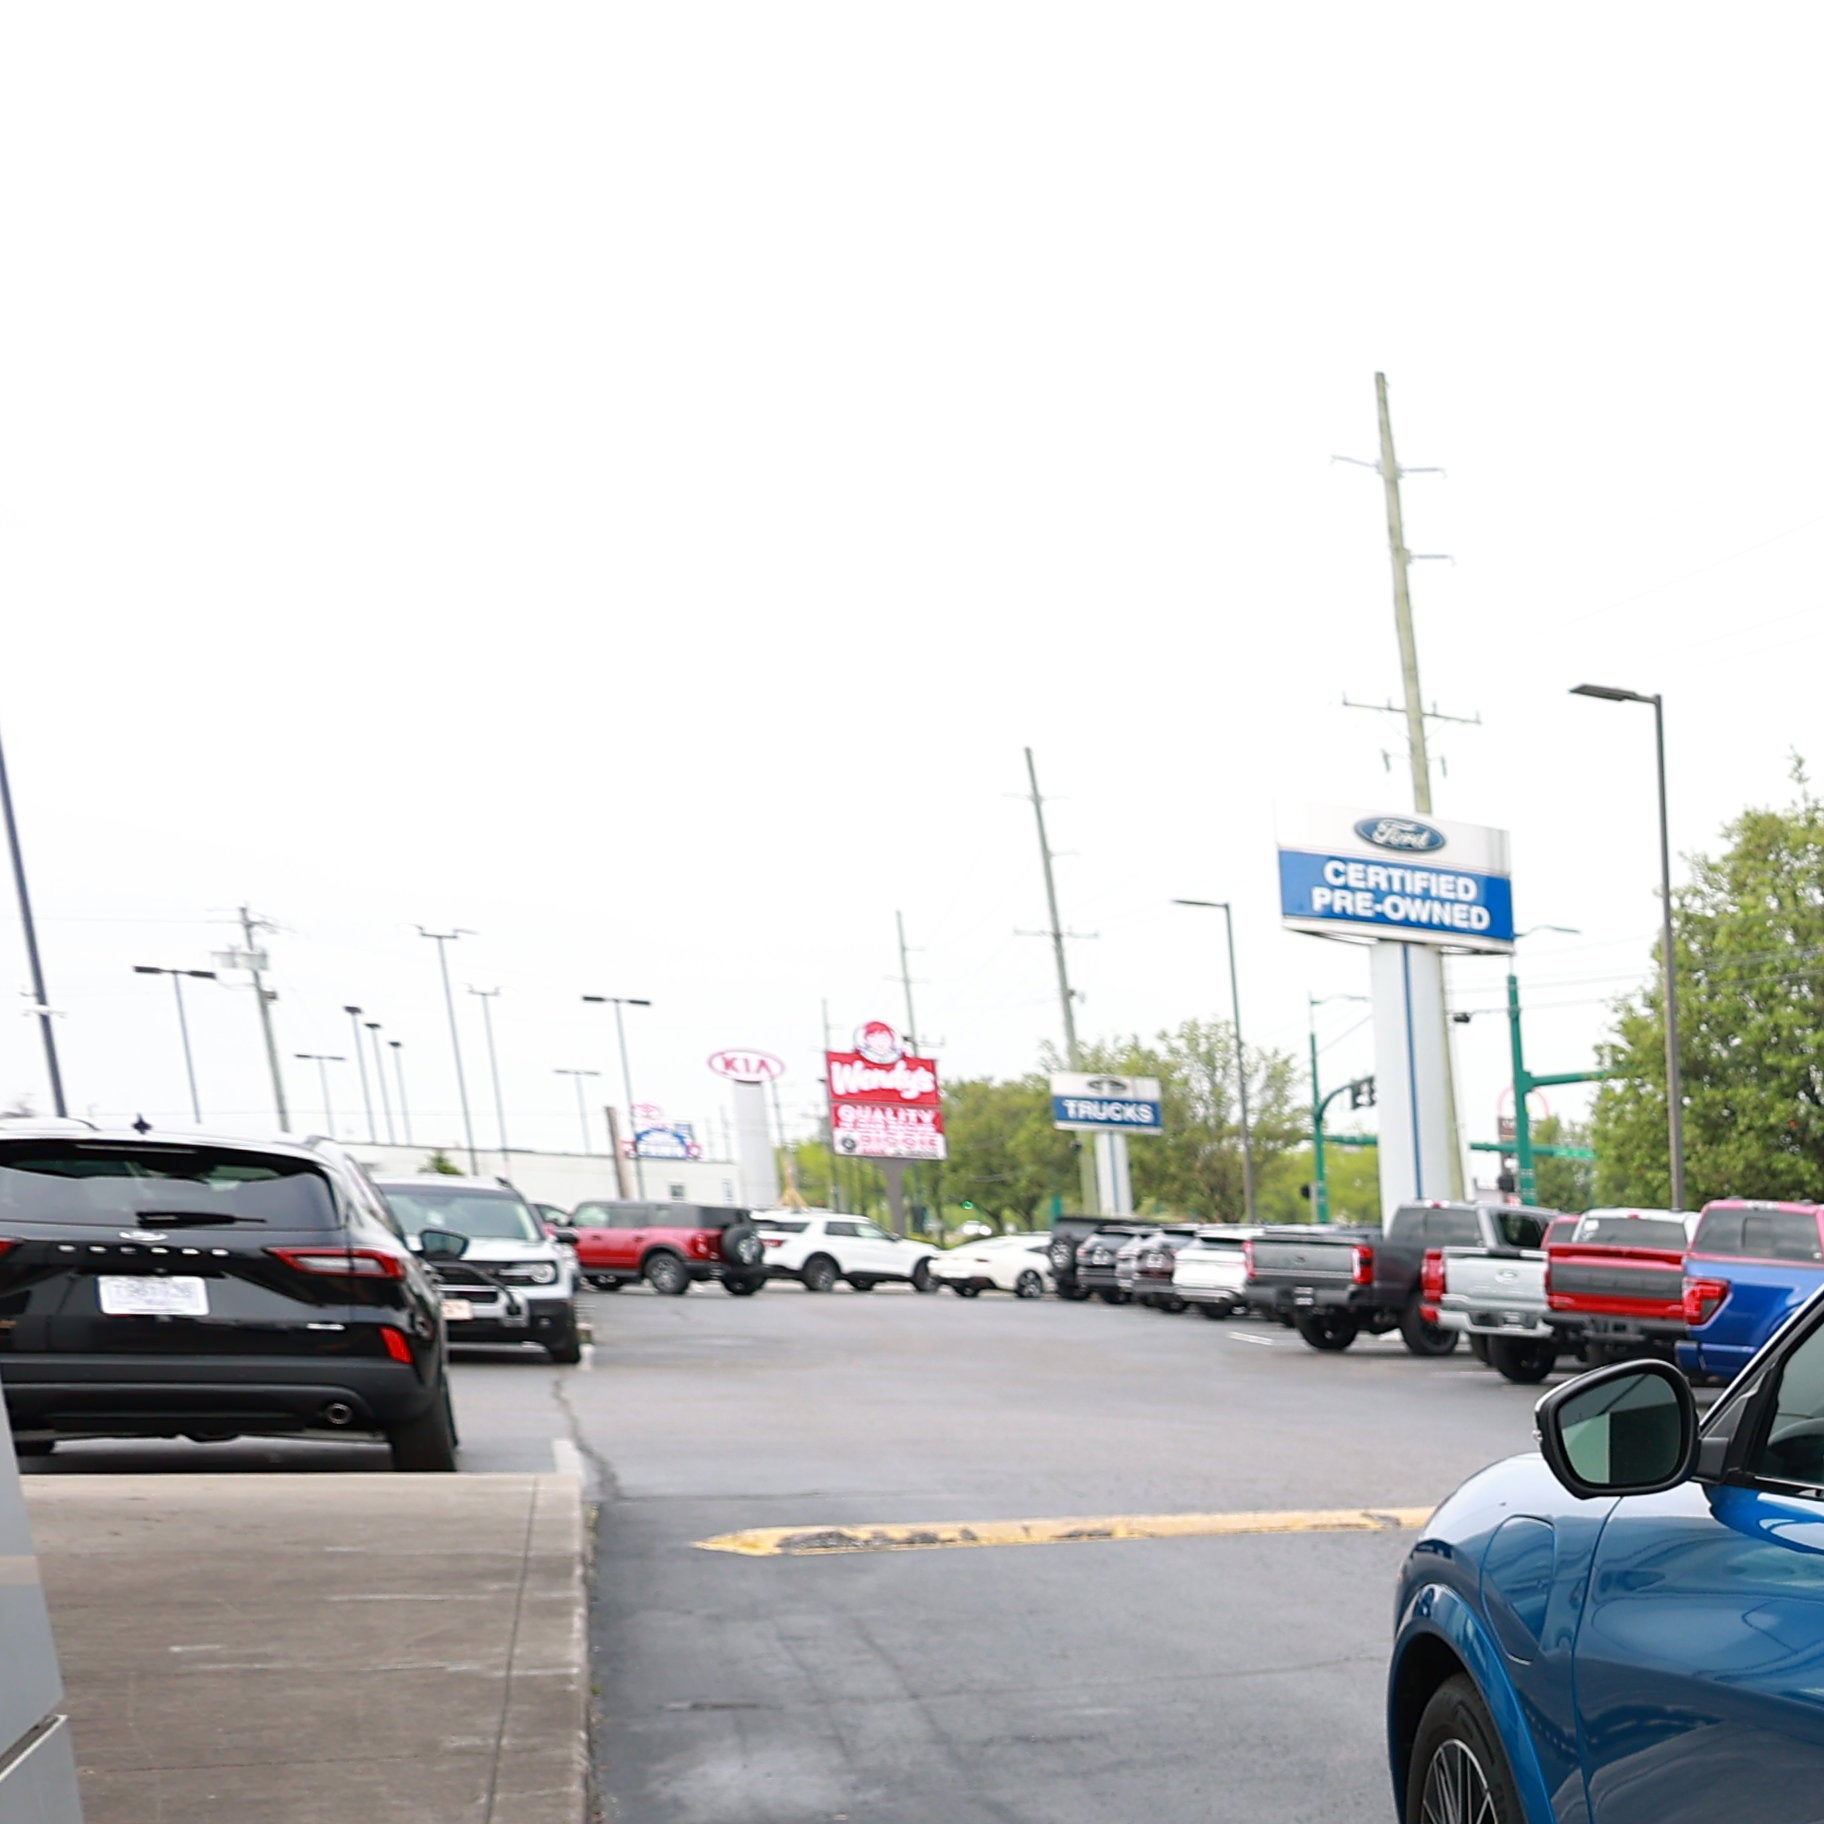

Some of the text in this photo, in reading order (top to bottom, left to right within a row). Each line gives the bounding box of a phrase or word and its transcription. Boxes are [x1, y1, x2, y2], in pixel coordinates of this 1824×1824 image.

[1372, 818, 1431, 849] Ford
[1323, 860, 1478, 901] CERTIFIED
[1311, 886, 1491, 931] PRE-OWNED
[721, 1056, 773, 1076] KIA
[1062, 1099, 1155, 1123] TRUCKS
